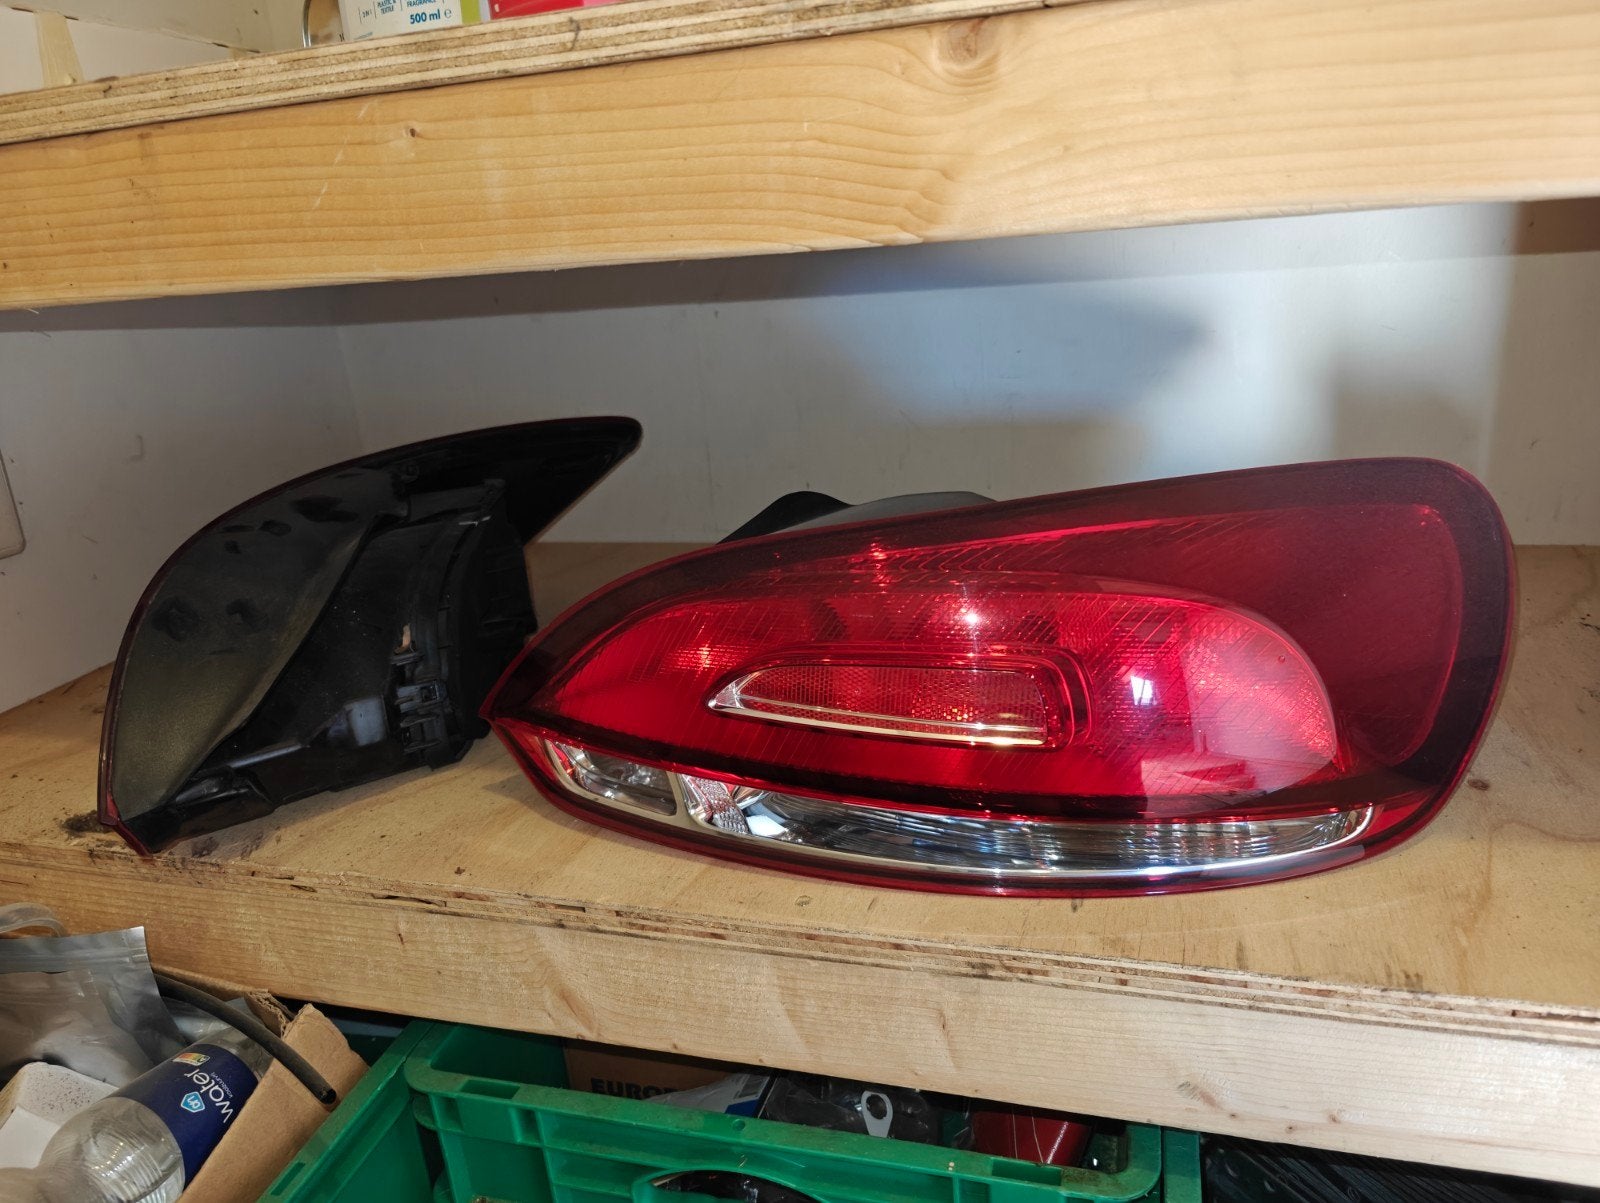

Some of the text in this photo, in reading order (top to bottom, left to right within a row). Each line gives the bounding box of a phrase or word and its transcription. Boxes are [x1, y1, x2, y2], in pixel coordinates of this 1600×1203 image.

[410, 12, 427, 24] 500
[429, 9, 441, 21] ml
[183, 1068, 233, 1123] water
